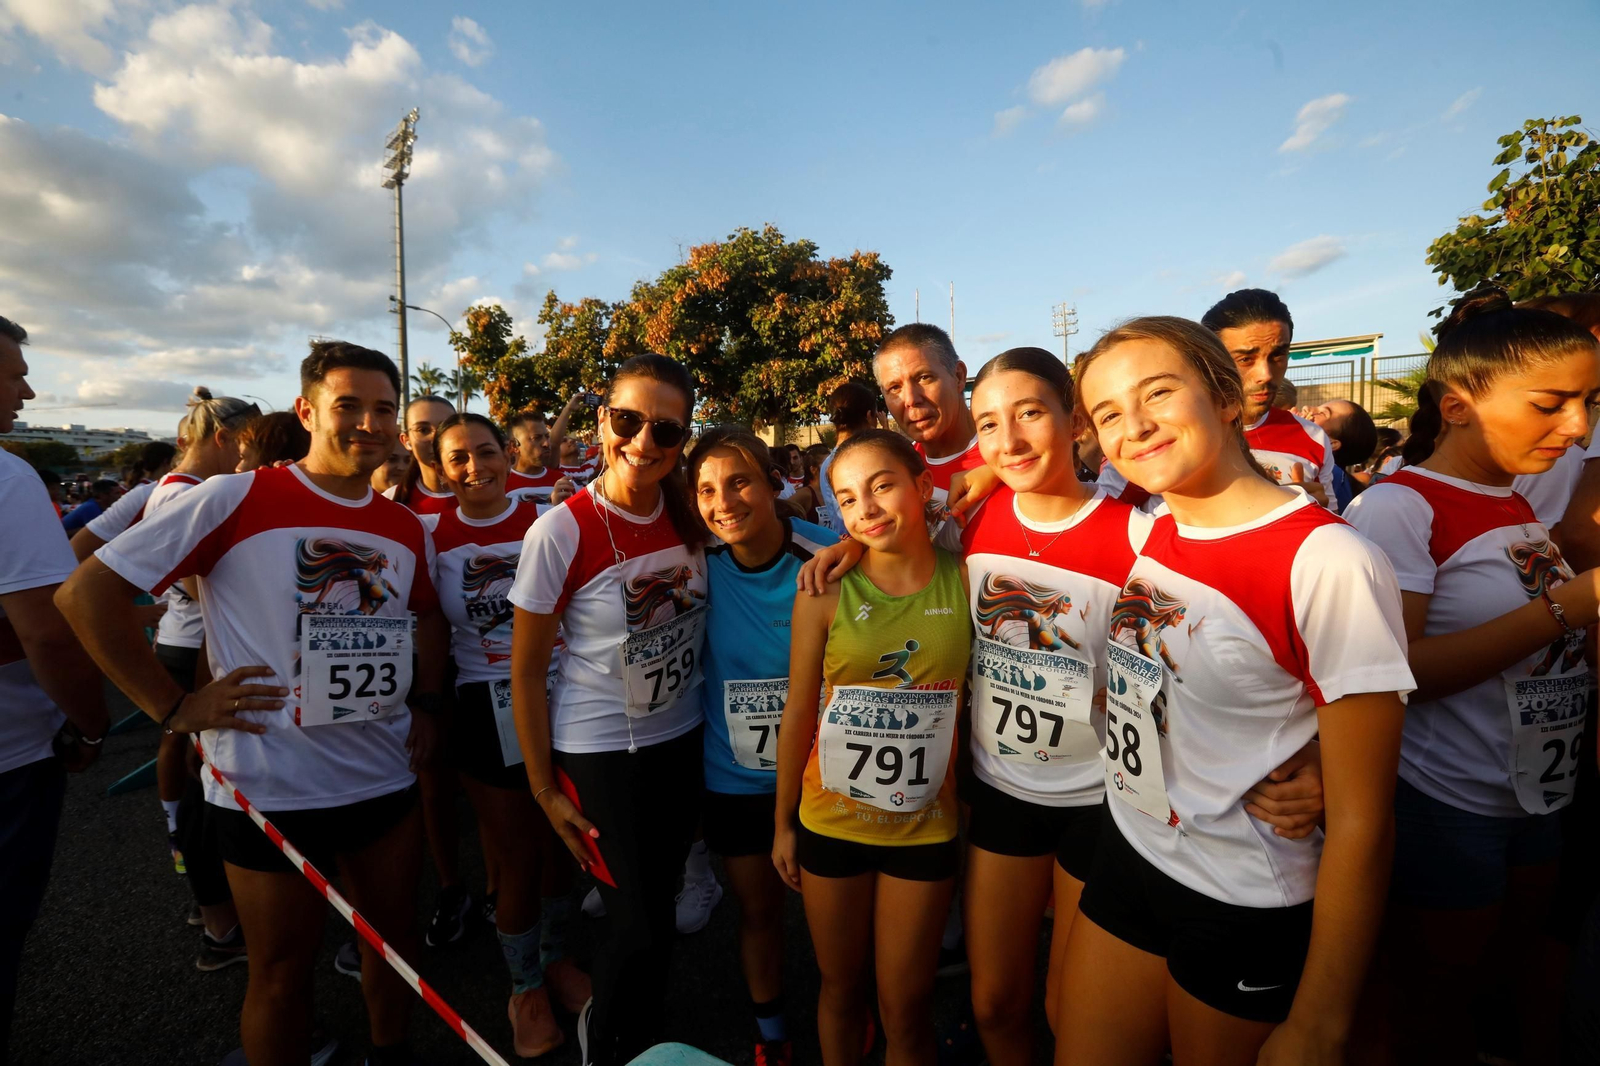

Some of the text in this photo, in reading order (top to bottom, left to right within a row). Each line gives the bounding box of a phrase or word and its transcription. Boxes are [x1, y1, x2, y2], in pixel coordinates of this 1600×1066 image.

[924, 607, 953, 616] AINHOA
[309, 631, 355, 641] 2024
[978, 640, 1009, 653] CIRCUITO
[1010, 648, 1070, 664] PROVINCIAL
[978, 645, 1088, 675] CARRERAS POPULARES
[977, 655, 1013, 673] 2024
[1111, 653, 1160, 682] POPULARES
[328, 662, 397, 700] 523
[644, 647, 695, 703] 759
[1516, 678, 1573, 689] CIRCUITO
[1516, 680, 1582, 695] CARRERAS
[729, 695, 769, 705] 2024
[837, 694, 889, 704] CARRERAS
[839, 689, 877, 697] CIRCUITO
[880, 690, 939, 699] PROVINCIAL
[830, 703, 879, 718] 2024
[1518, 695, 1574, 712] 2024
[992, 695, 1064, 747] 797
[852, 730, 872, 738] CARRERA
[1106, 709, 1142, 777] 58
[846, 742, 929, 786] 791
[877, 814, 890, 824] EL
